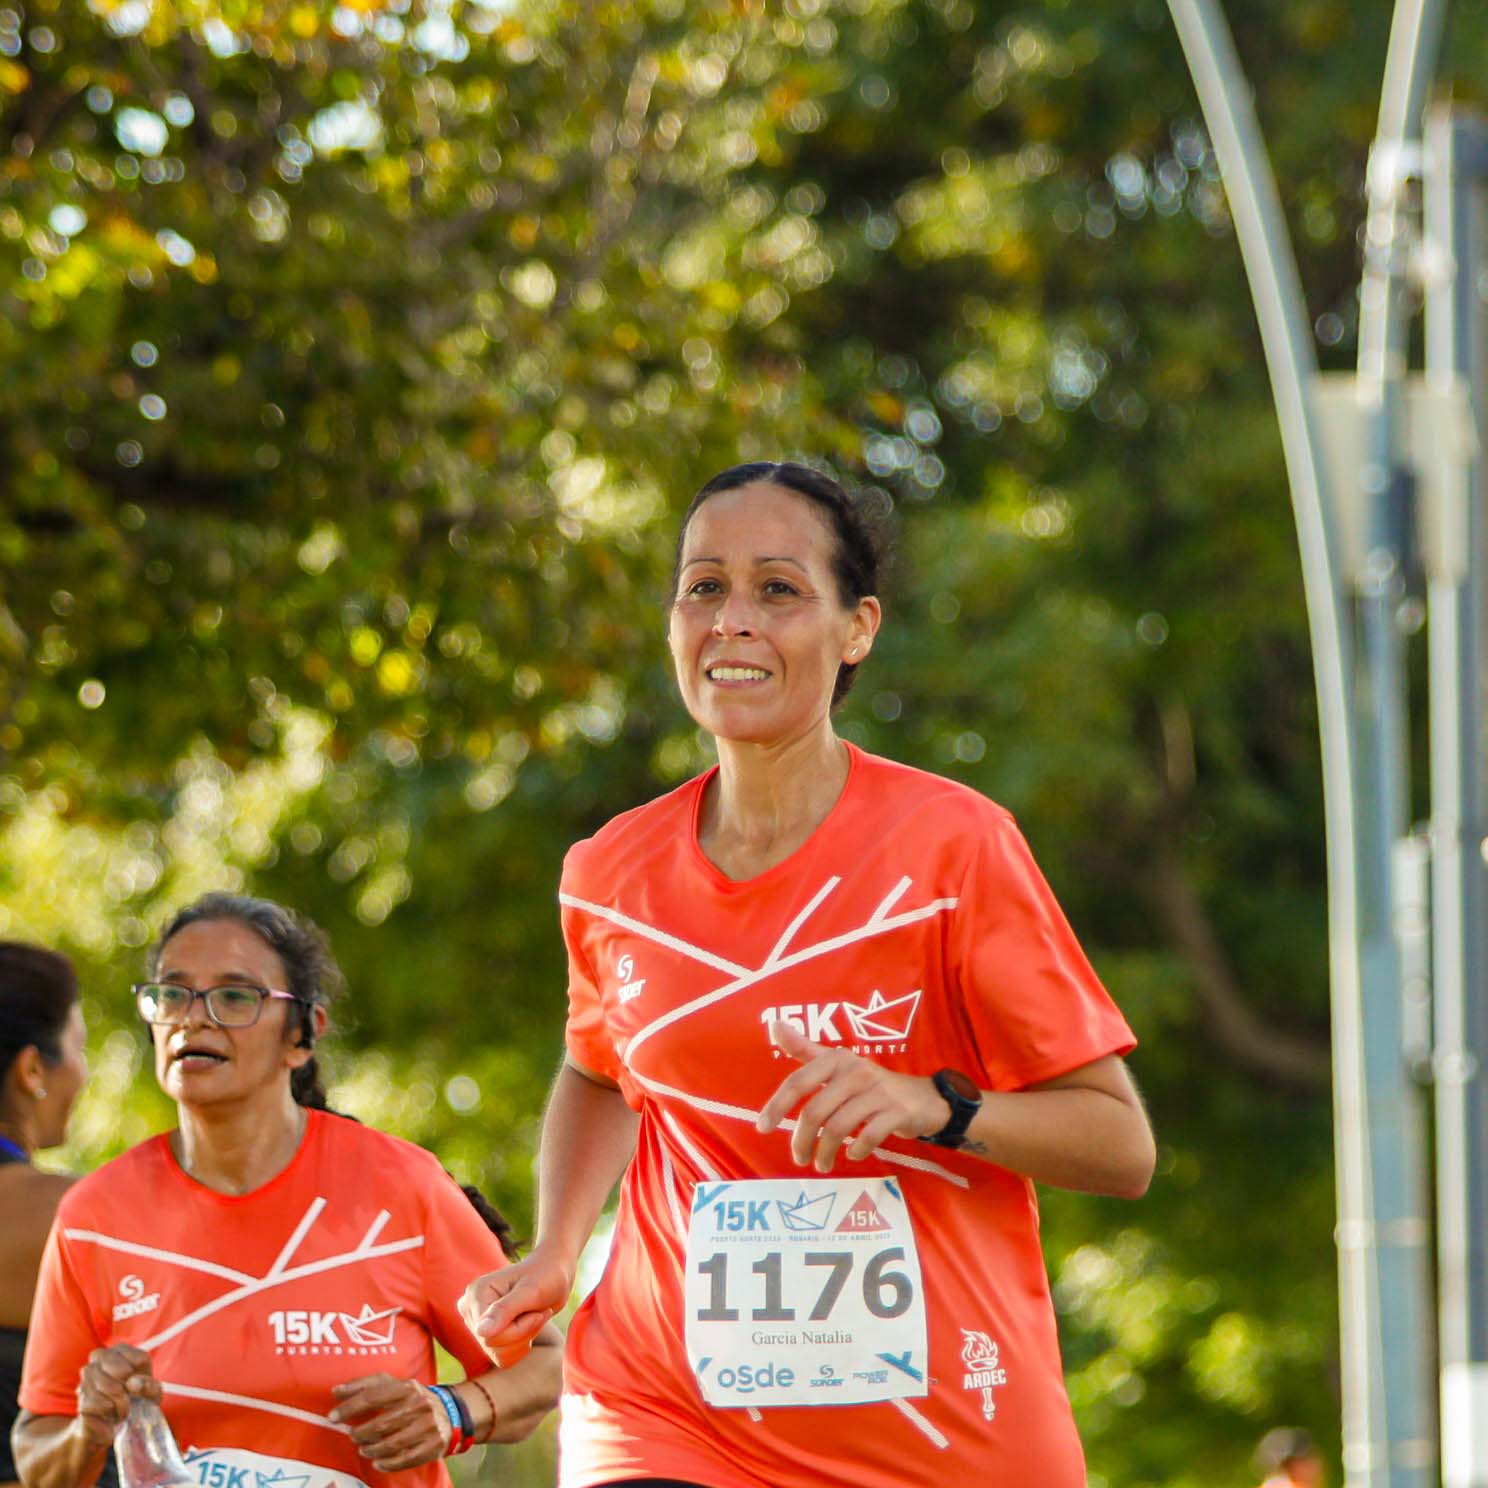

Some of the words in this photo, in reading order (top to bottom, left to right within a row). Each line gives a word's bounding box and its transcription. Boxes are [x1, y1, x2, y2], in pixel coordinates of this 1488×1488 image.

[761, 1002, 843, 1046] 15K
[713, 1199, 771, 1232] 15K
[848, 1210, 881, 1228] 15K
[697, 1246, 914, 1322] 1176
[268, 1310, 341, 1345] 15K
[751, 1330, 798, 1346] Garcia
[802, 1330, 853, 1345] Natalia
[963, 1368, 1007, 1390] ARDEC
